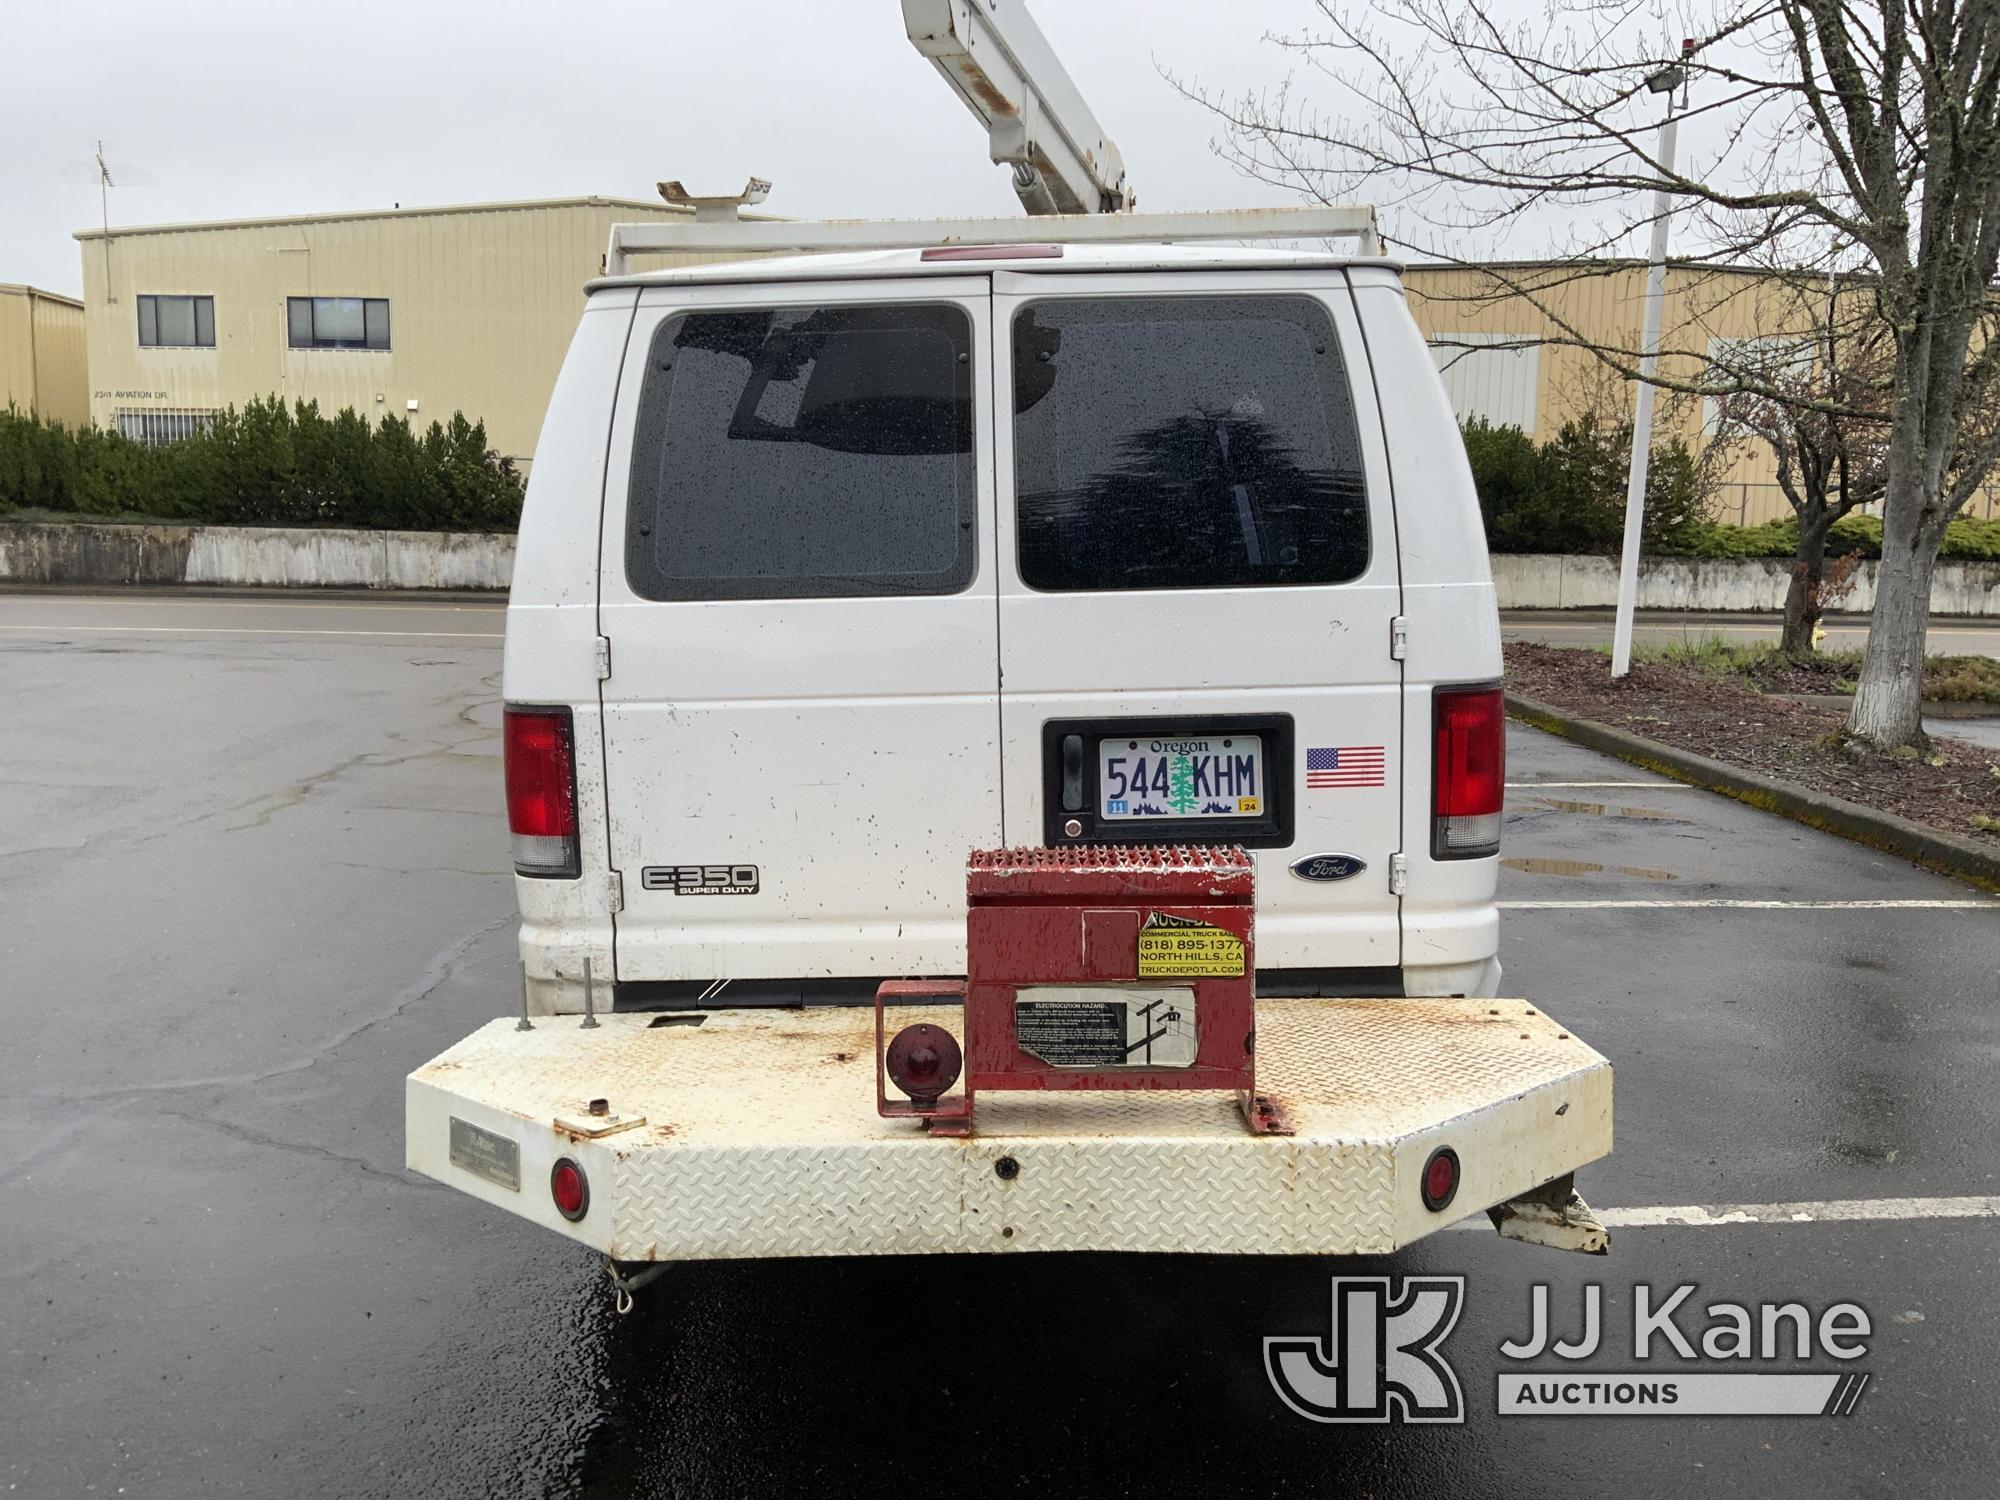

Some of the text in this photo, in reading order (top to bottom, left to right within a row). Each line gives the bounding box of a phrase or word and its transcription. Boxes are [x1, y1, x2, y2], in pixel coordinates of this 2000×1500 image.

[115, 391, 152, 399] AVIATION
[1150, 740, 1210, 756] Oregon
[1107, 754, 1255, 799] 544 KHM
[1111, 802, 1256, 813] 11 24
[1309, 859, 1348, 876] Ford
[642, 866, 758, 890] E-350
[1140, 940, 1242, 950] (818) 895-1377
[1140, 953, 1182, 961] NORTH
[1226, 952, 1243, 961] CA
[1140, 966, 1243, 974] TRUCKDEPOTLA.COM
